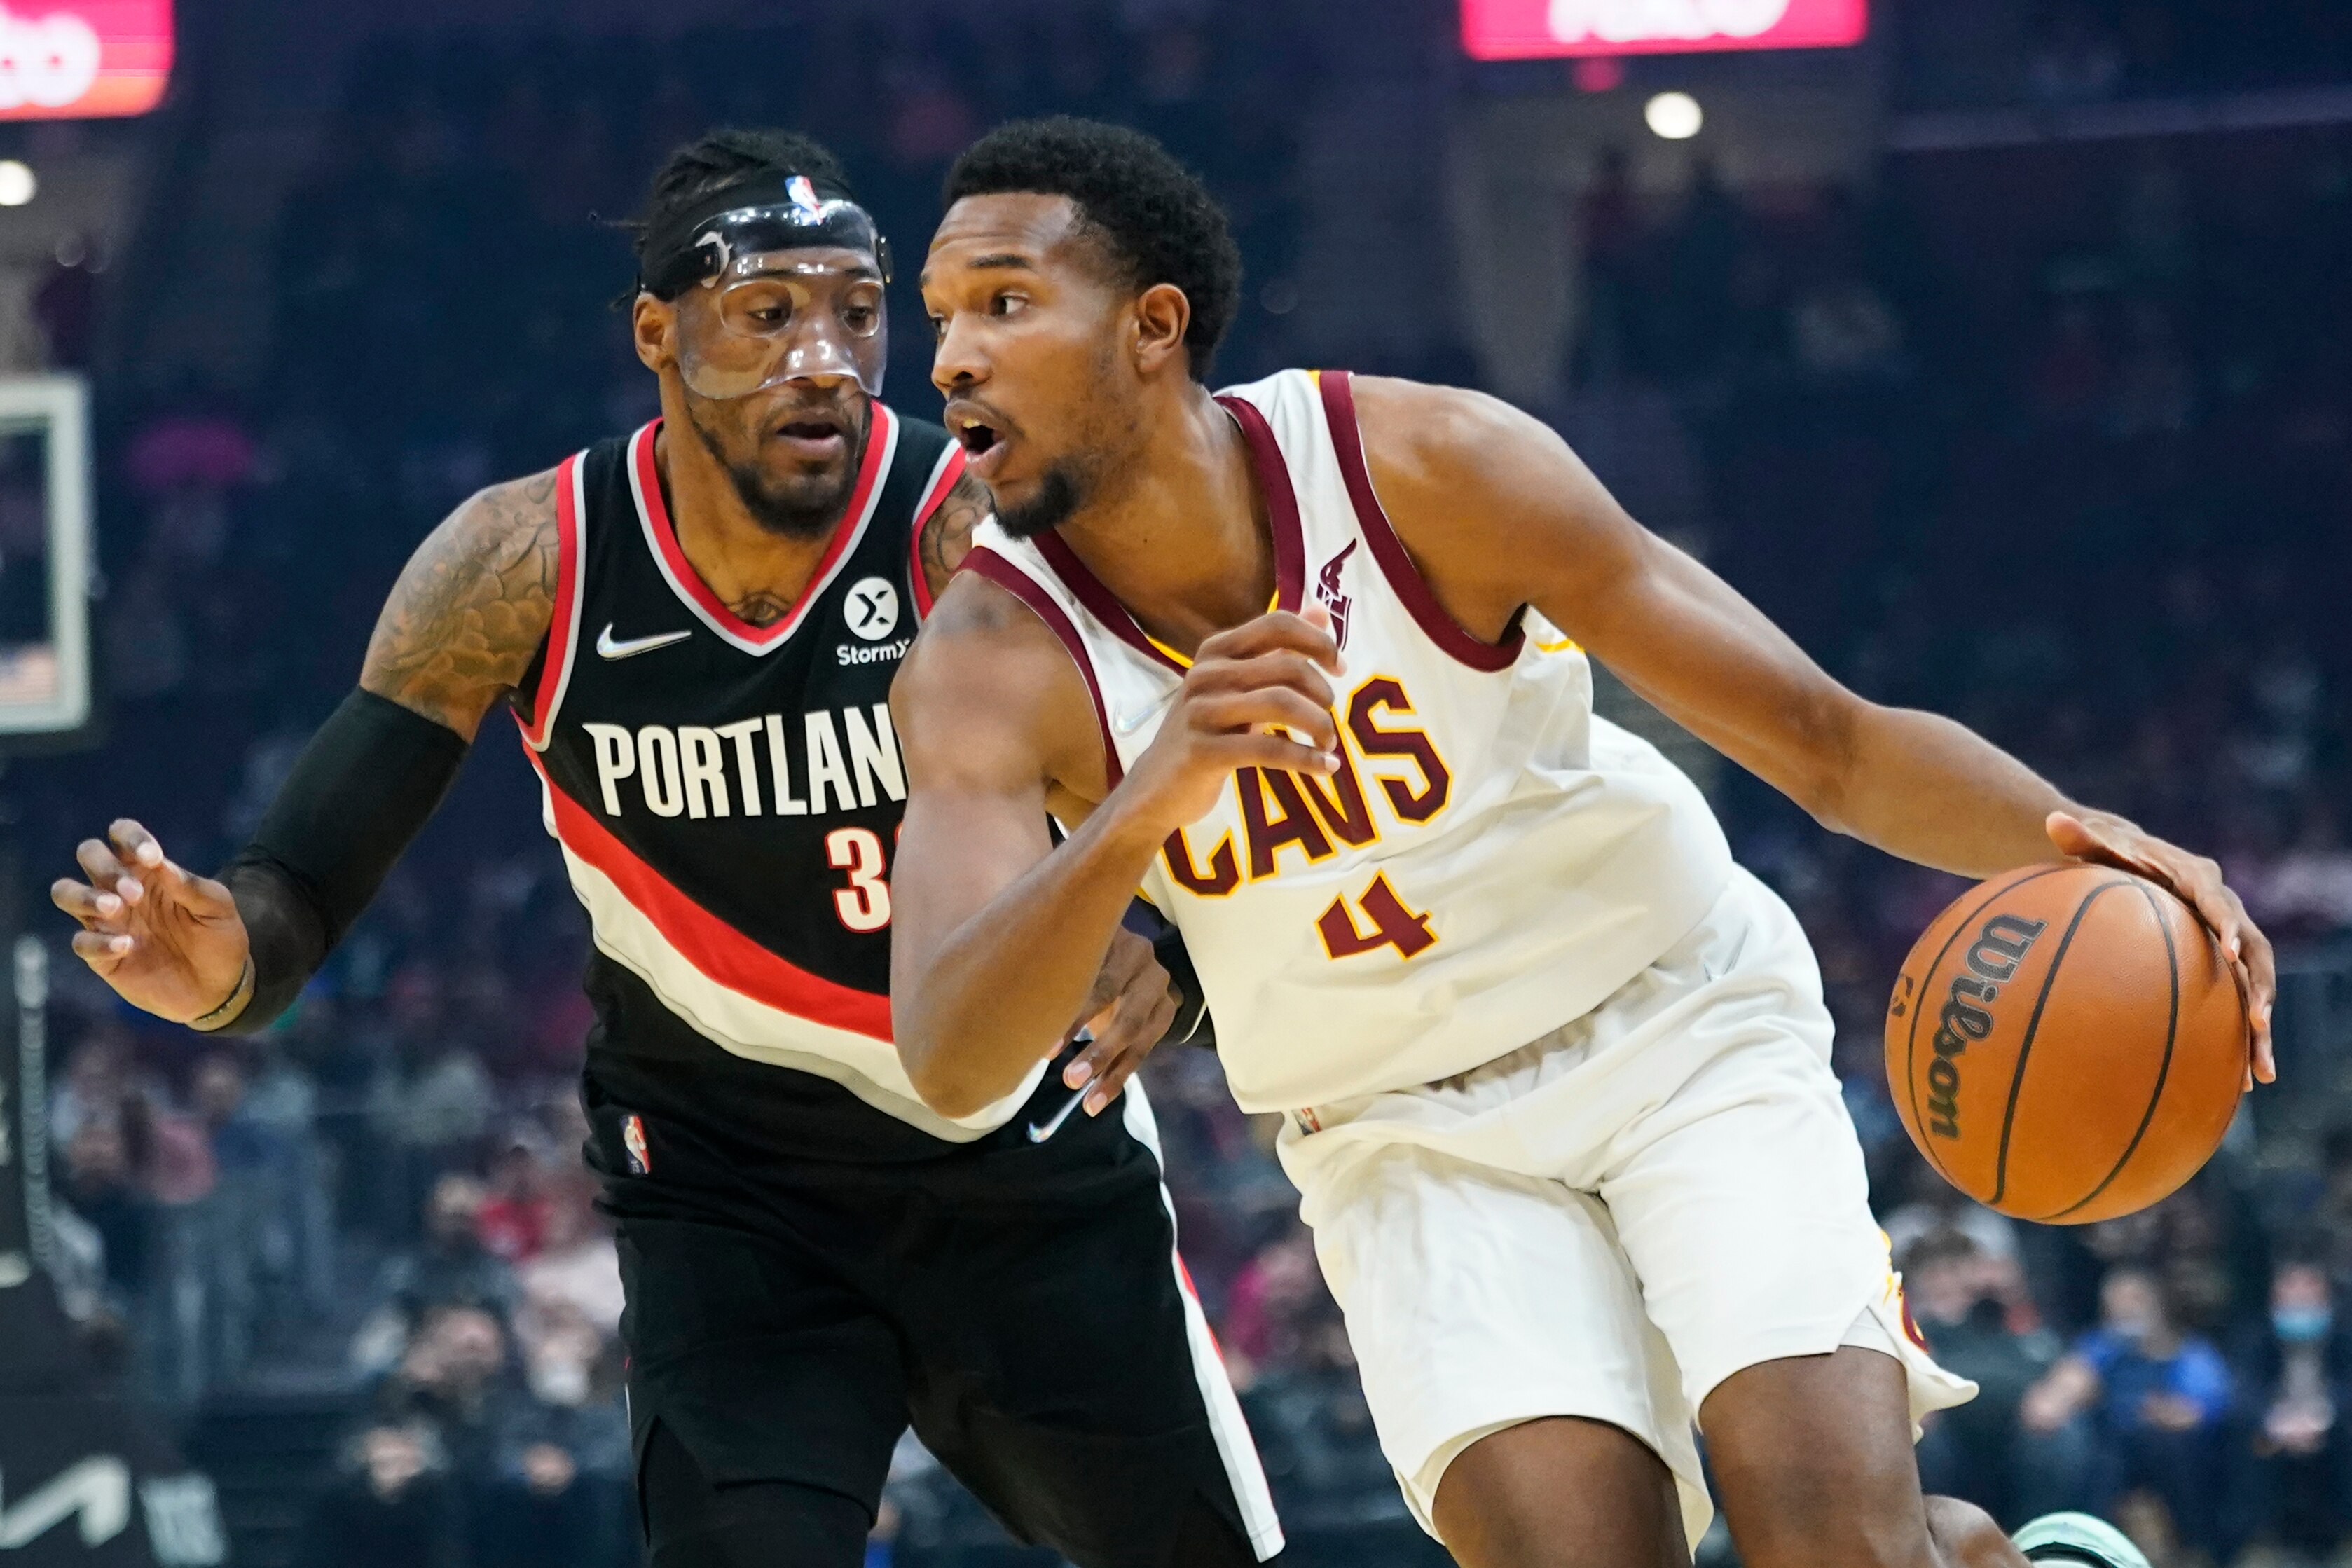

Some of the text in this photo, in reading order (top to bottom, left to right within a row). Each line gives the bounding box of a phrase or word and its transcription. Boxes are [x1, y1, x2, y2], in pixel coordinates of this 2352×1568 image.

[836, 638, 911, 666] StormX
[582, 702, 910, 820] PORTLAN
[824, 821, 902, 933] 3
[1314, 868, 1440, 961] 4
[1927, 914, 2049, 1139] Wilson
